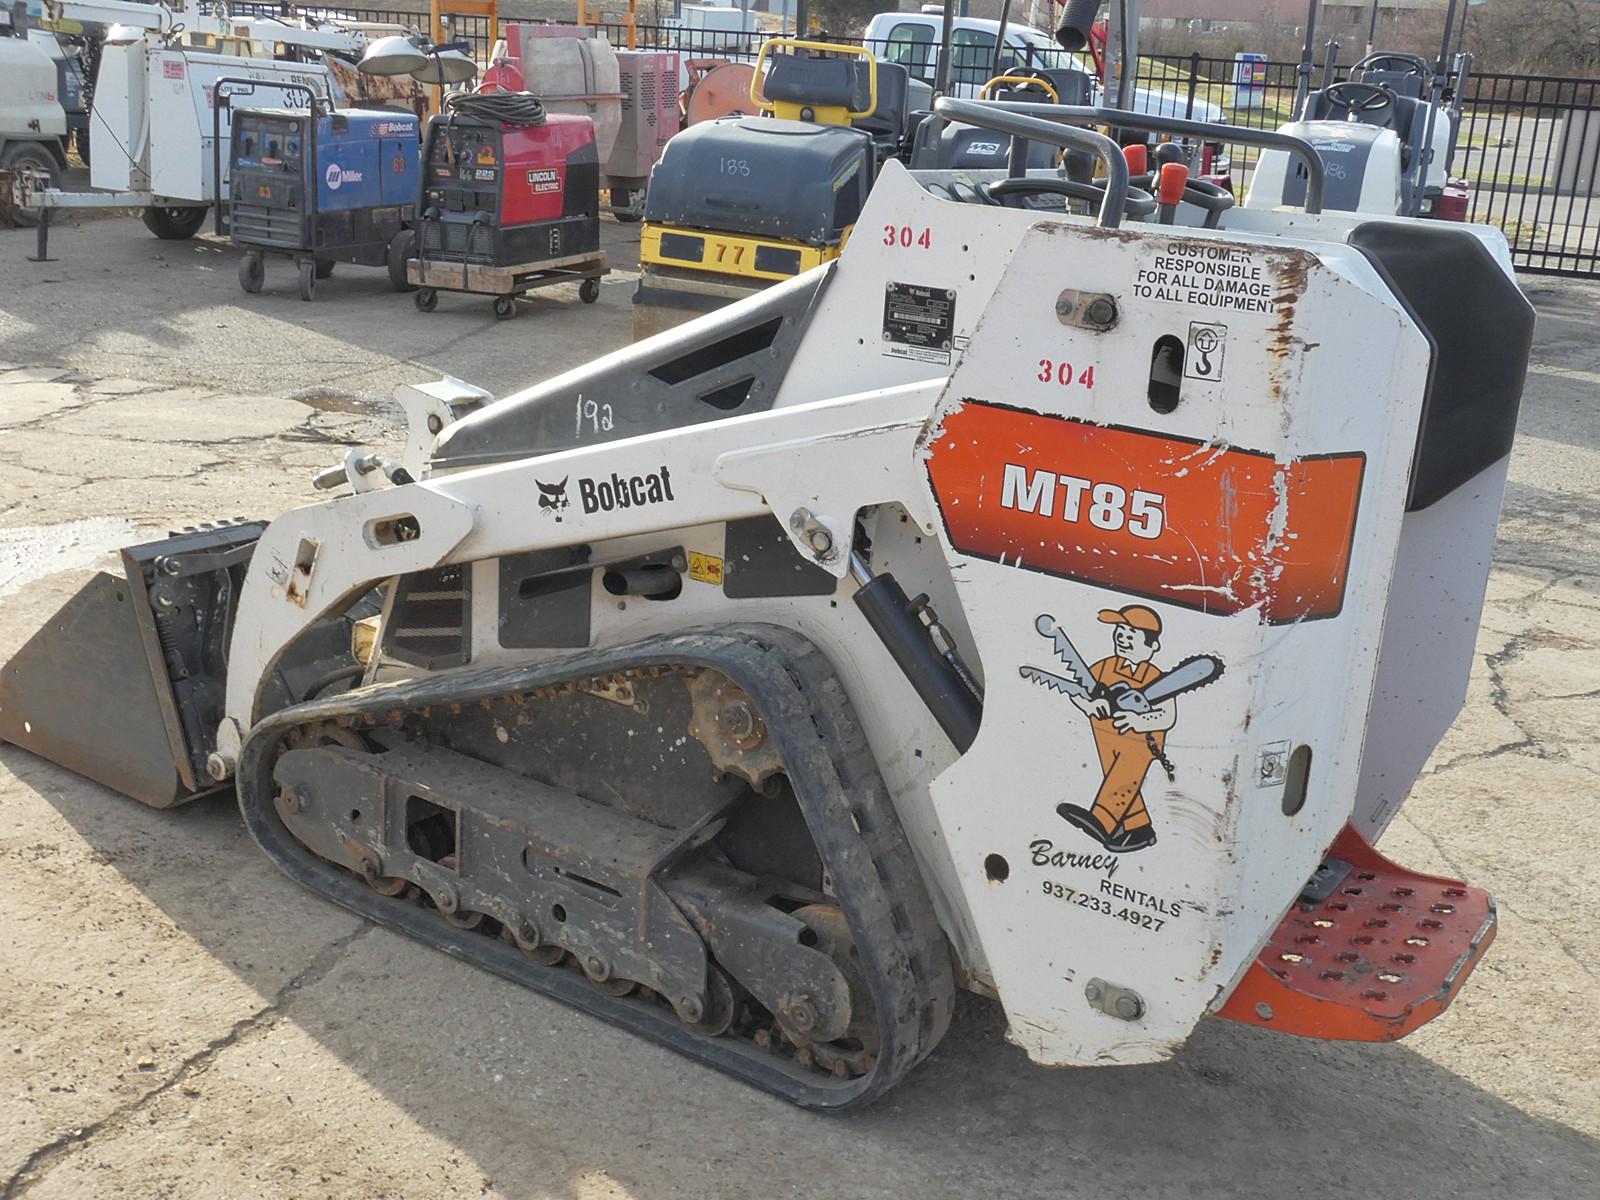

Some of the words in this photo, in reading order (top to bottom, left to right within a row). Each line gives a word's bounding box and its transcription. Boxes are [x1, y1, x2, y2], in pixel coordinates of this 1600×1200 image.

[388, 122, 414, 132] Bobcat
[342, 170, 363, 182] Miller
[528, 171, 556, 183] LINCOLN
[720, 156, 750, 176] 188
[535, 182, 559, 192] ELECTRIC
[883, 225, 931, 249] 304
[1167, 243, 1252, 263] CUSTOMER
[1154, 256, 1261, 280] RESPONSIBLE
[1137, 269, 1168, 285] FOR
[1171, 274, 1199, 289] ALL
[1204, 278, 1271, 298] DAMAGE
[1133, 284, 1152, 298] TO
[1155, 287, 1183, 302] ALL
[1187, 291, 1274, 314] EQUIPMENT
[1037, 359, 1095, 389] 304
[575, 393, 615, 439] 192
[578, 466, 674, 514] Bobcat
[1001, 463, 1165, 540] MT85
[1029, 839, 1119, 879] Barney
[1042, 880, 1165, 932] 937.233.4927
[1100, 879, 1183, 918] RENTALS
